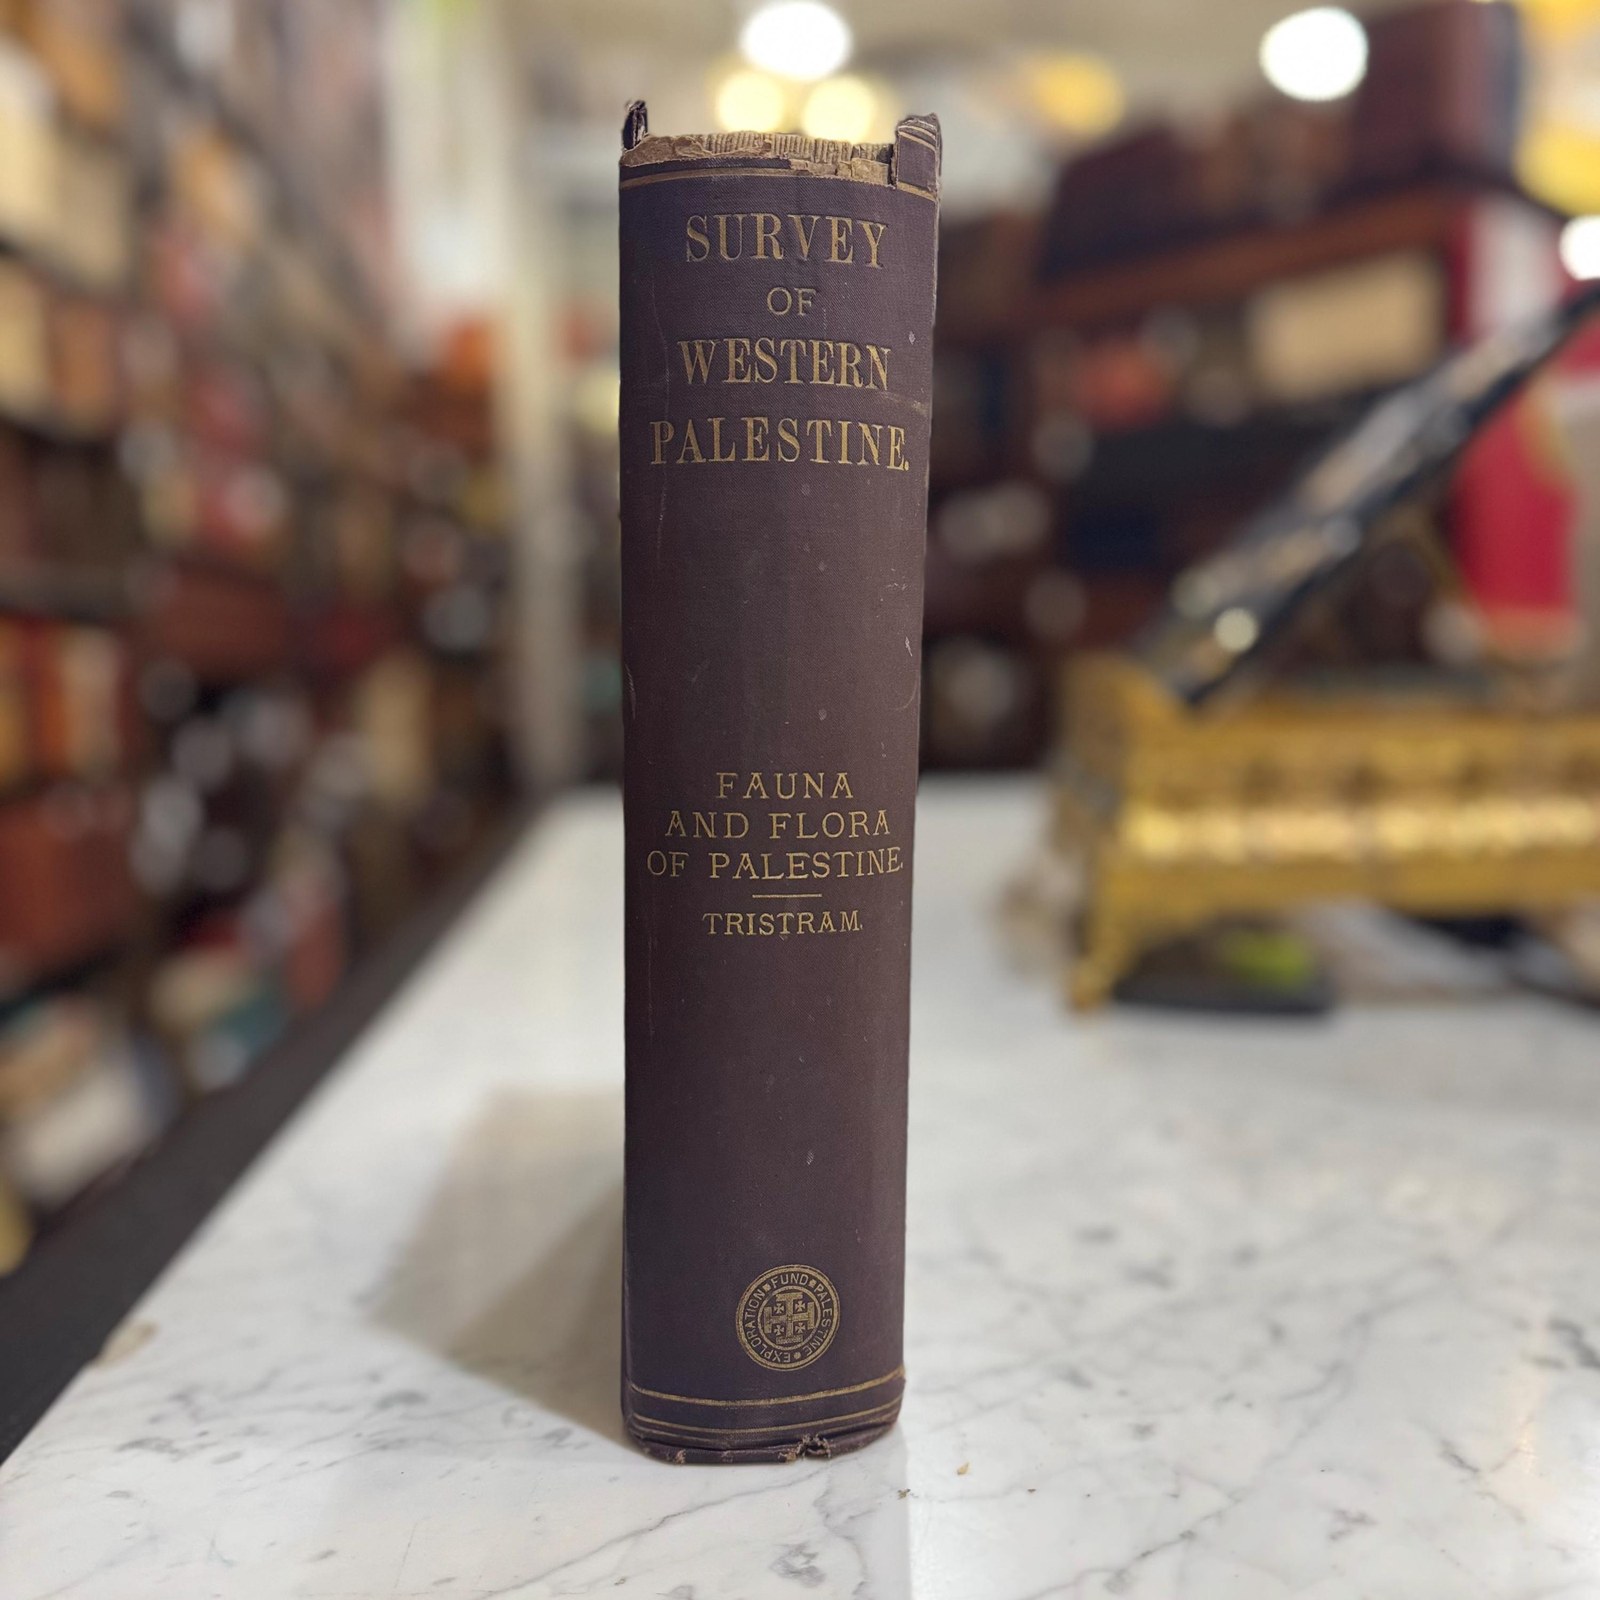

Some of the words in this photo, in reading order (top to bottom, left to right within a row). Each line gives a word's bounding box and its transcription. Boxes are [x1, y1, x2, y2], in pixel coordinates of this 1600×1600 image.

[686, 213, 889, 270] SURVEY
[766, 287, 817, 317] OF
[677, 338, 892, 392] WESTERN
[650, 417, 910, 471] PALESTINE.
[716, 772, 854, 800] FAUNA
[665, 810, 750, 839] AND
[768, 809, 891, 840] FLORA
[647, 850, 690, 878] OF
[770, 1273, 809, 1289] FUND
[744, 1288, 791, 1363] EXPLORATION
[802, 1283, 833, 1357] PALESTINE
